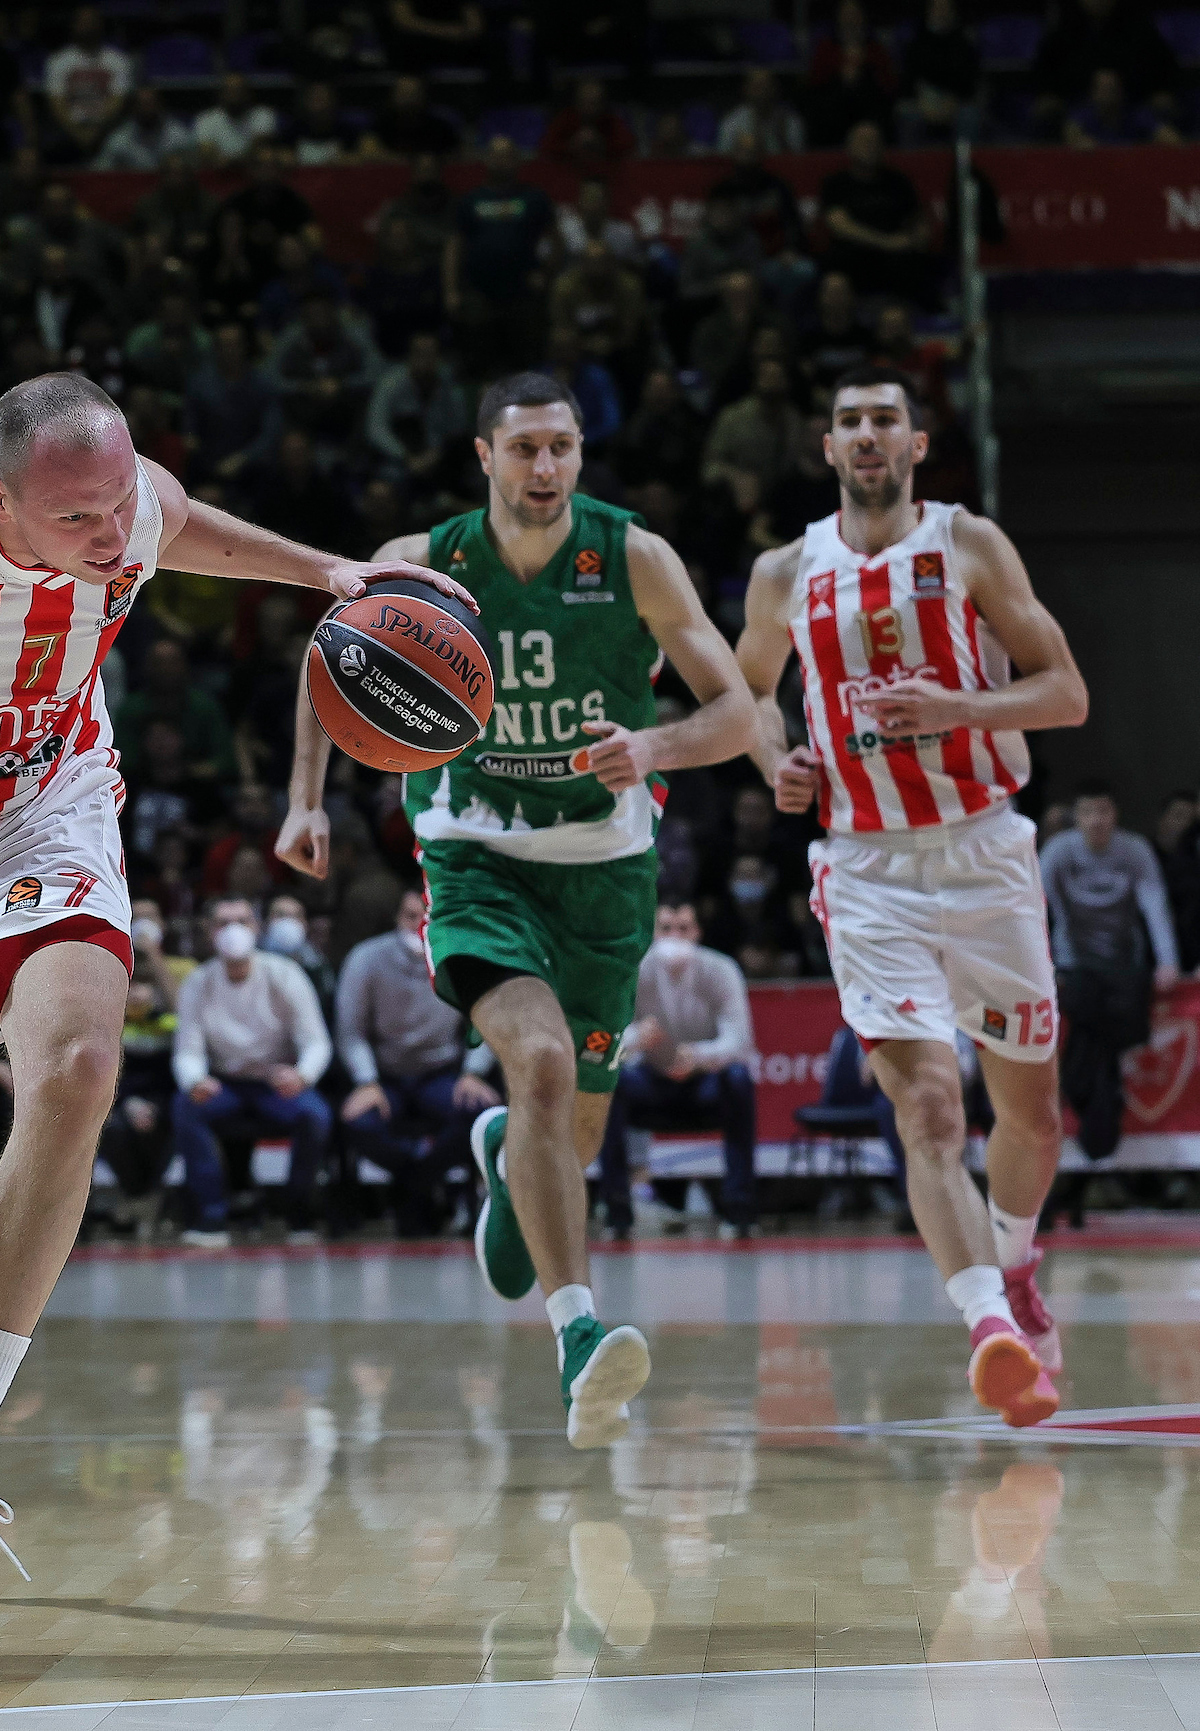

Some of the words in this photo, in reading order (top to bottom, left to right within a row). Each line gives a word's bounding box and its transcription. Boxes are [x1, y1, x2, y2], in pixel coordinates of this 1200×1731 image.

[21, 631, 67, 689] 7
[370, 605, 486, 700] SPALDING
[498, 630, 556, 690] 13
[854, 606, 904, 660] 13
[360, 675, 433, 734] EuroLeague
[370, 665, 418, 707] TURKISH
[416, 703, 461, 733] AIRLINES
[470, 690, 605, 745] NICS
[57, 871, 99, 908] 7
[1015, 998, 1056, 1046] 13
